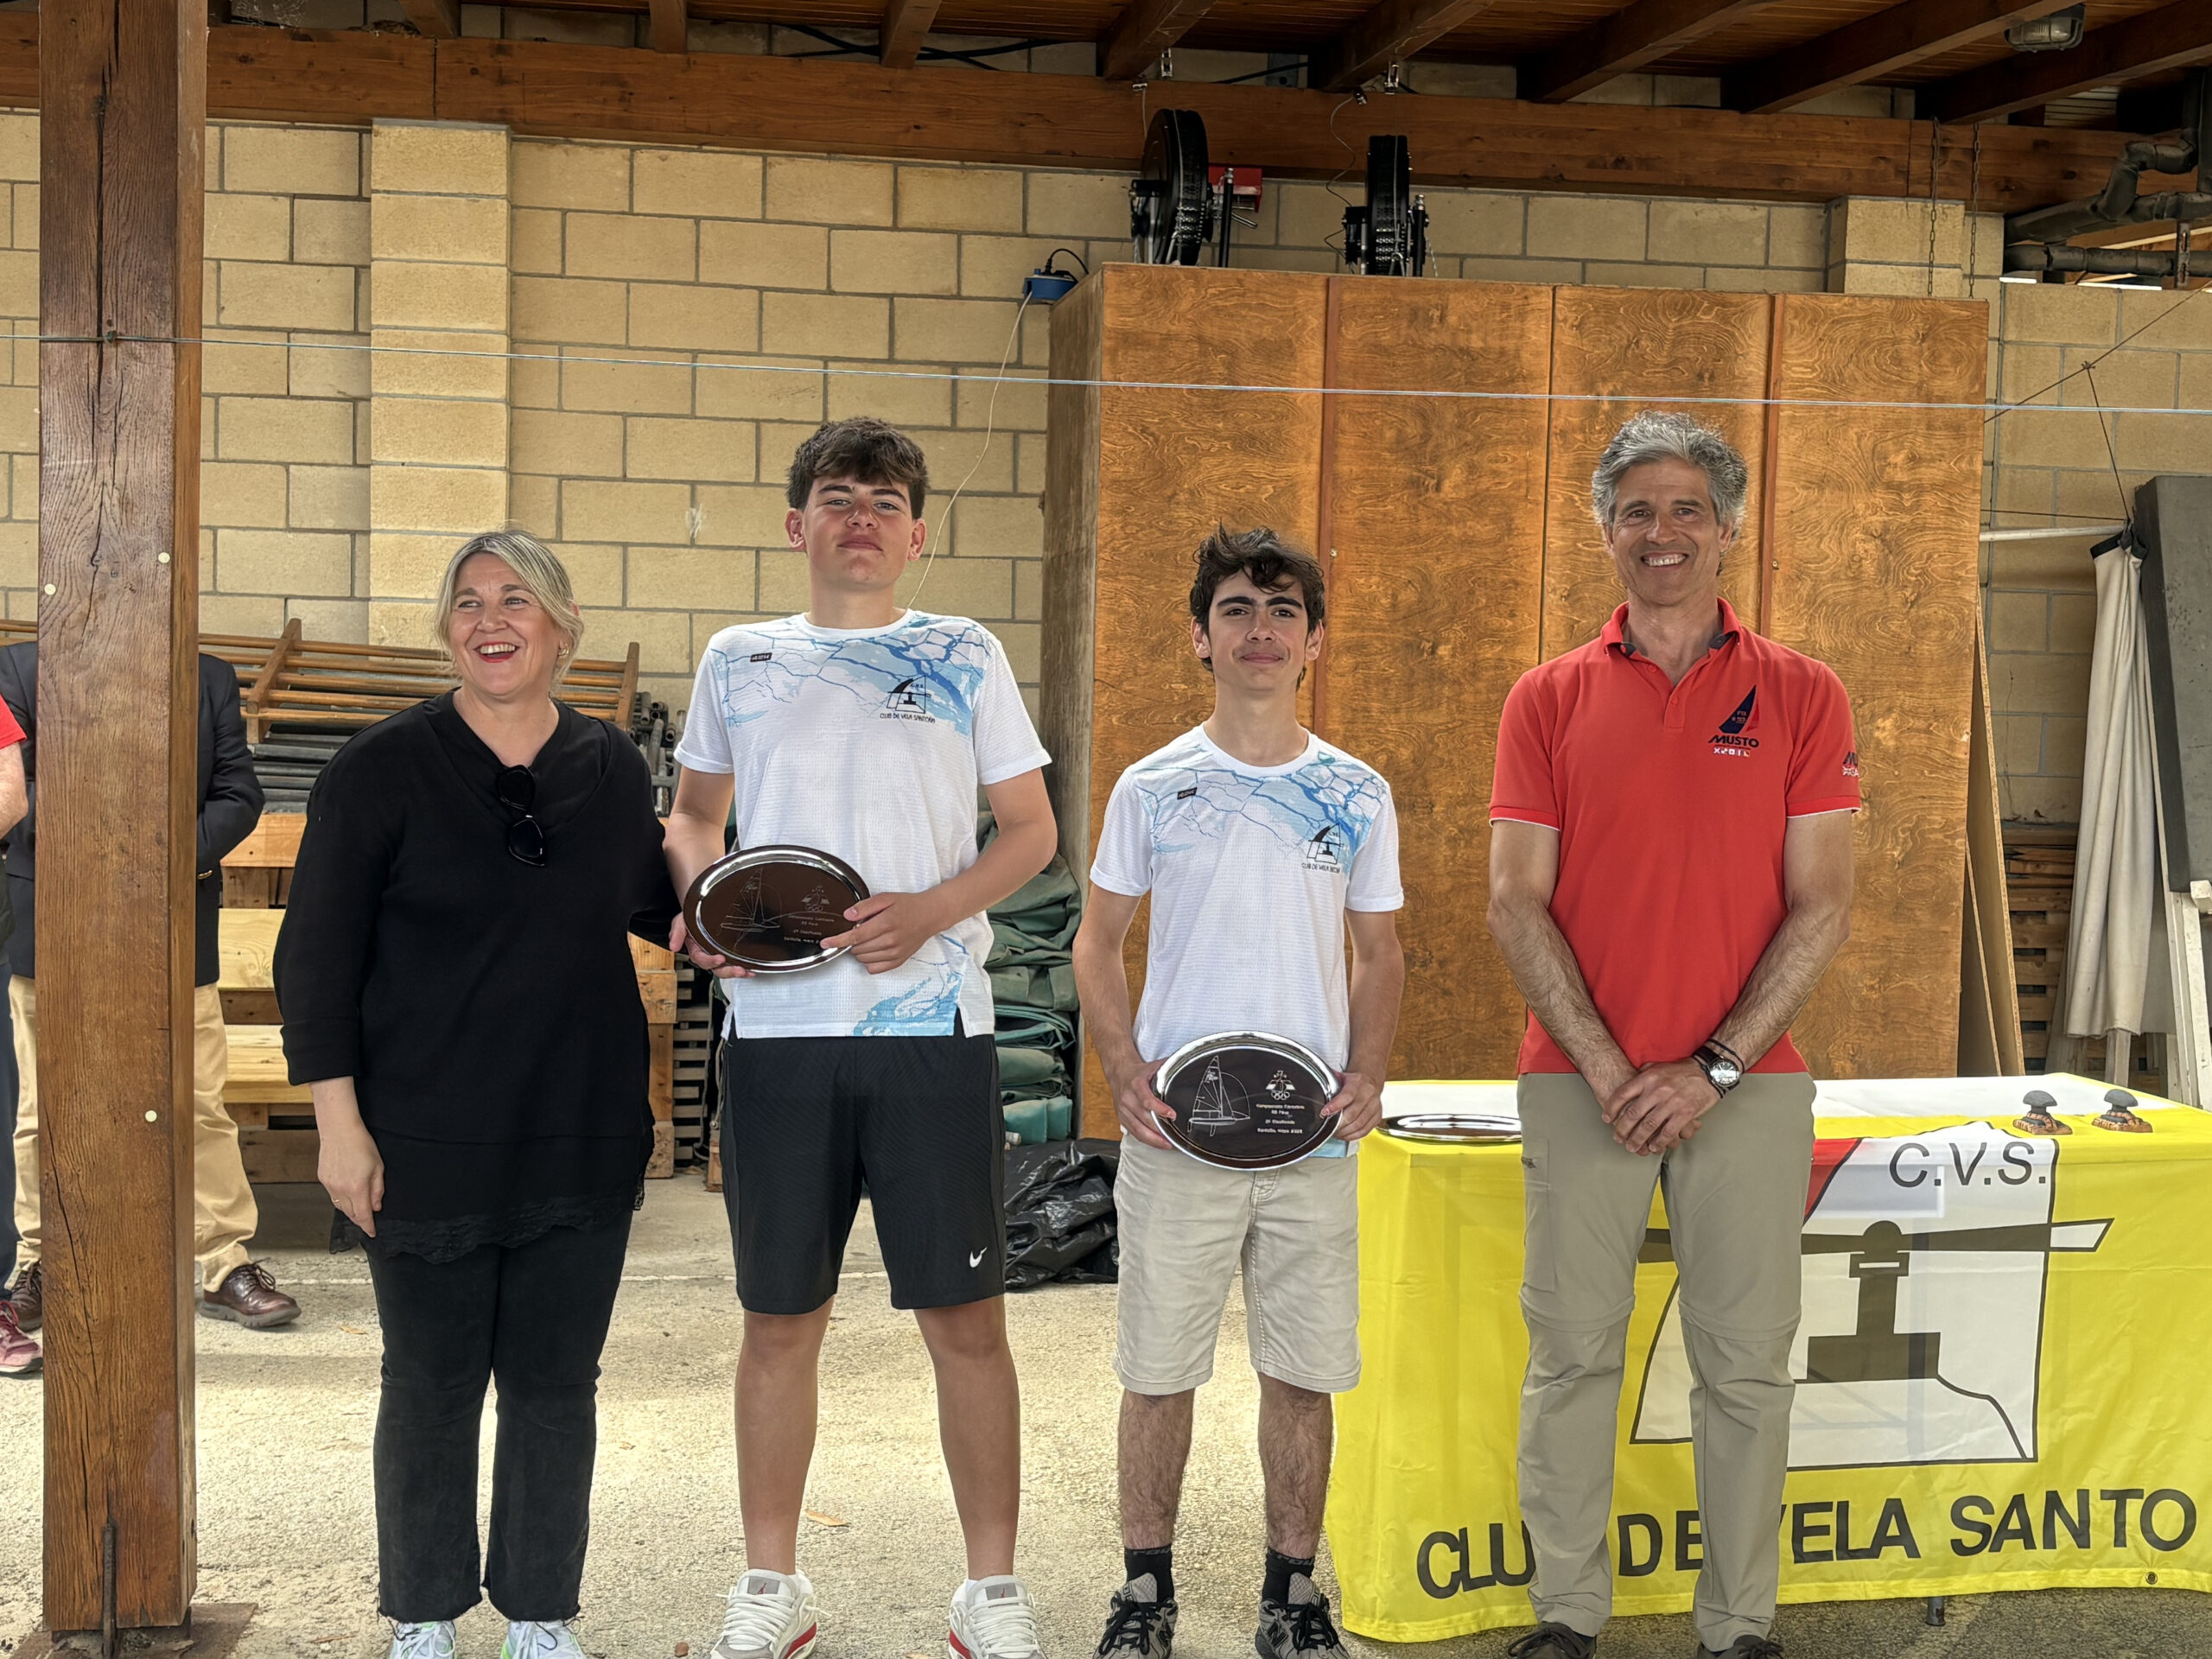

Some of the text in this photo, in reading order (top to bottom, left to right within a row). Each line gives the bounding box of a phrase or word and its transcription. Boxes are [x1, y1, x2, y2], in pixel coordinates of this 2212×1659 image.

[1708, 734, 1760, 748] MUSTO
[1889, 1141, 2046, 1188] C.V.S.
[1416, 1488, 2197, 1599] CLU DE ELA SANTO
